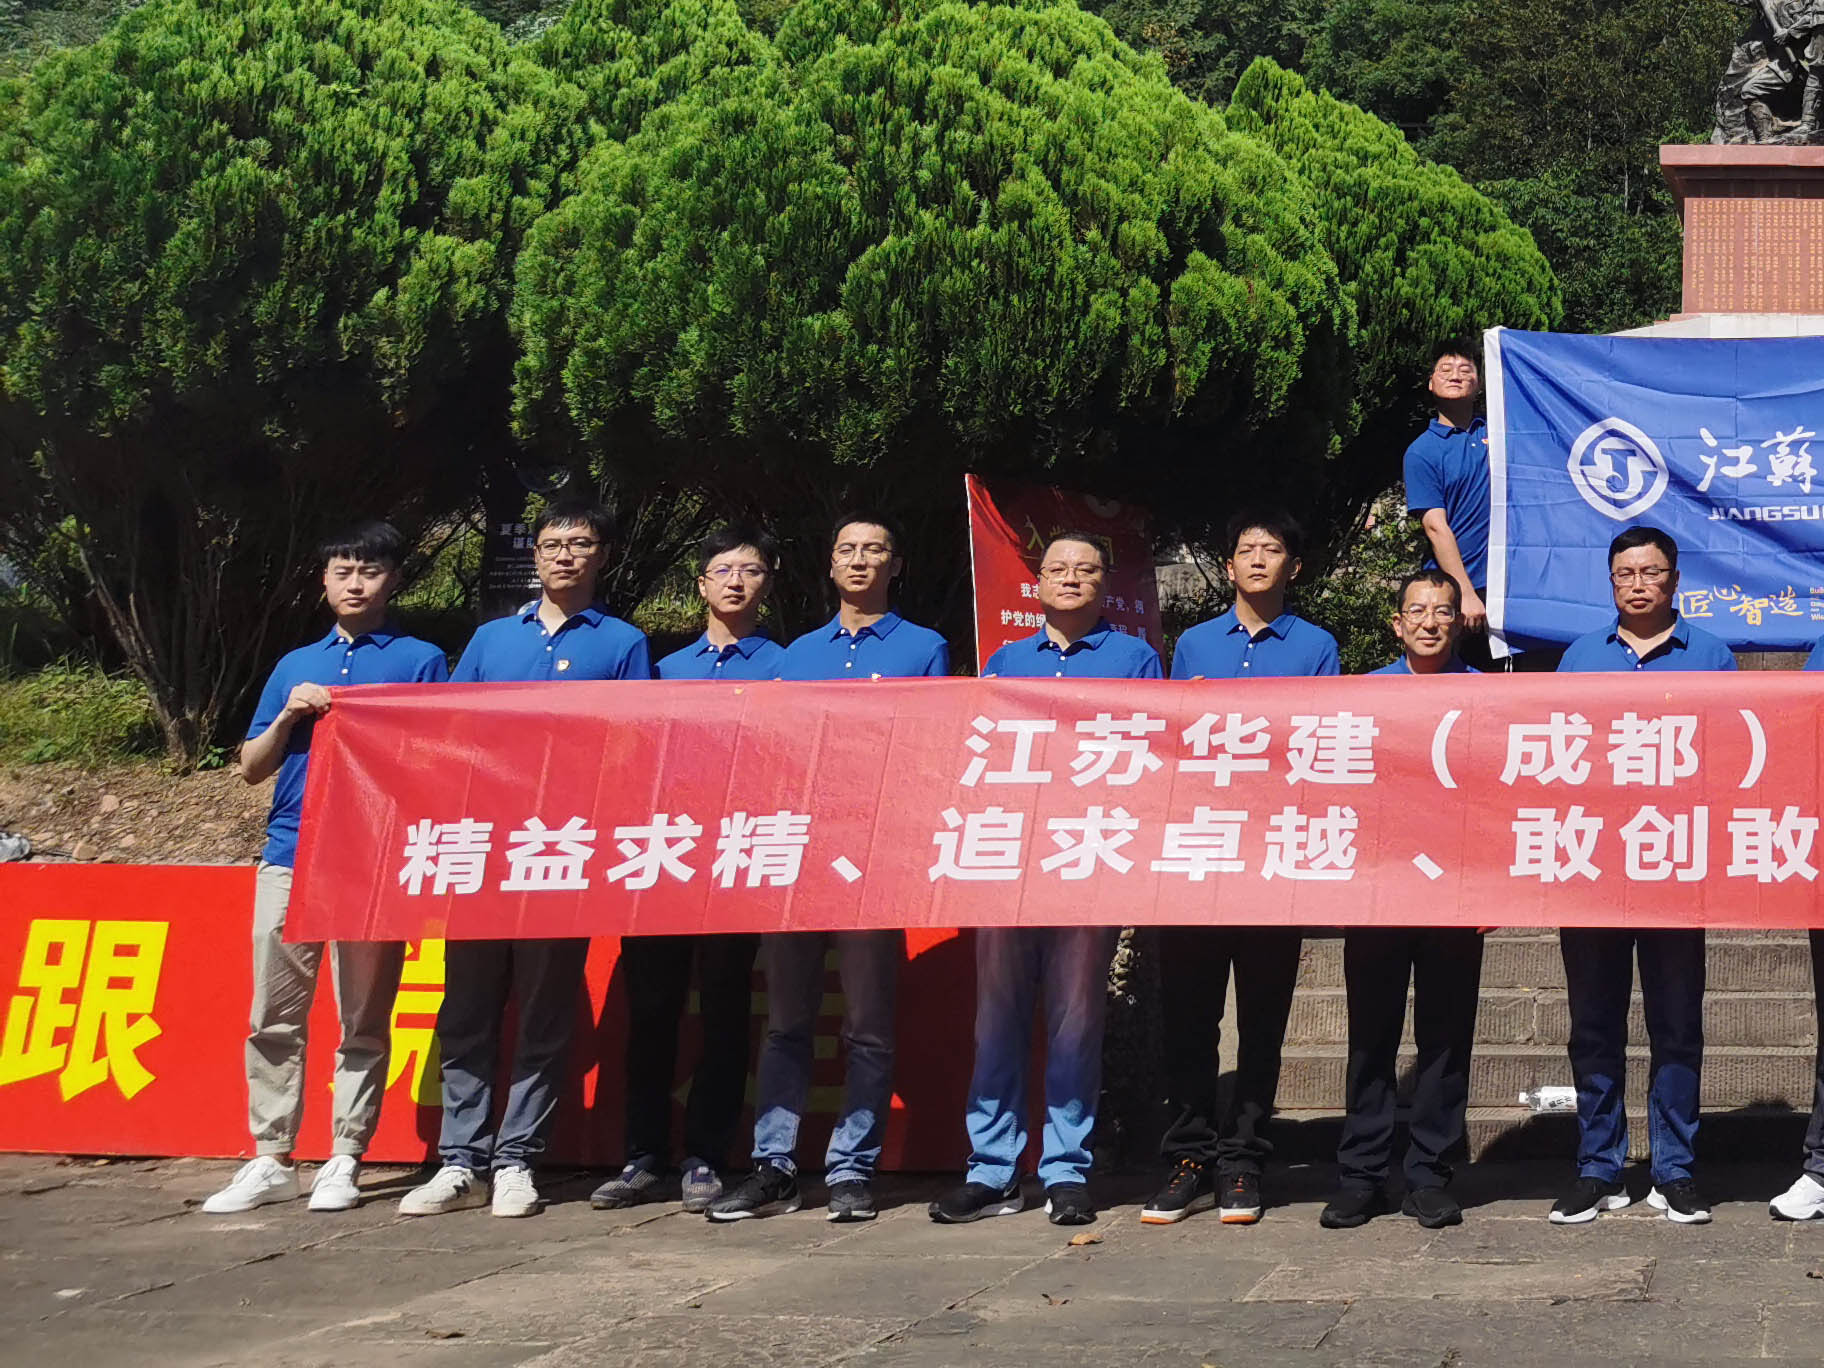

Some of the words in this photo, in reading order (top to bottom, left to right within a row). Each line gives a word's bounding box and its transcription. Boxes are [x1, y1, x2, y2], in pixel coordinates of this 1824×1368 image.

[1678, 584, 1804, 626] 匠心智造
[0, 919, 169, 1101] 跟
